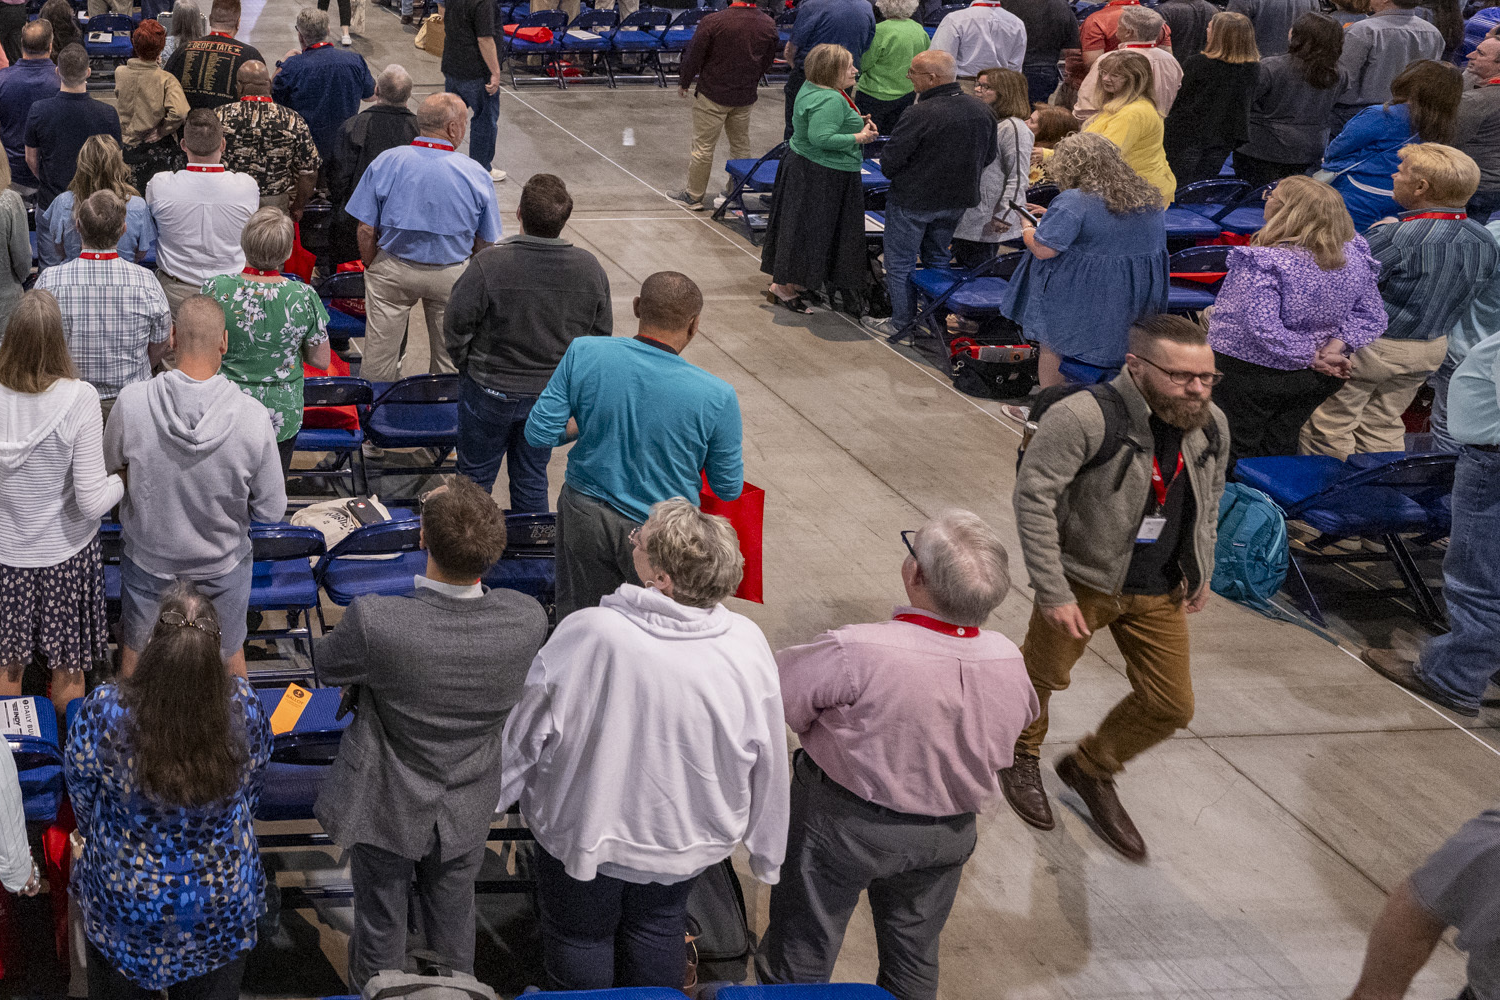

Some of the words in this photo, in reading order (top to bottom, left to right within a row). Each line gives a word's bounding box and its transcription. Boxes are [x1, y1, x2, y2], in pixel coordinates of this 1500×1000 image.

[192, 42, 214, 50] GEOFF
[215, 43, 234, 53] TATE
[23, 705, 32, 724] DAILY
